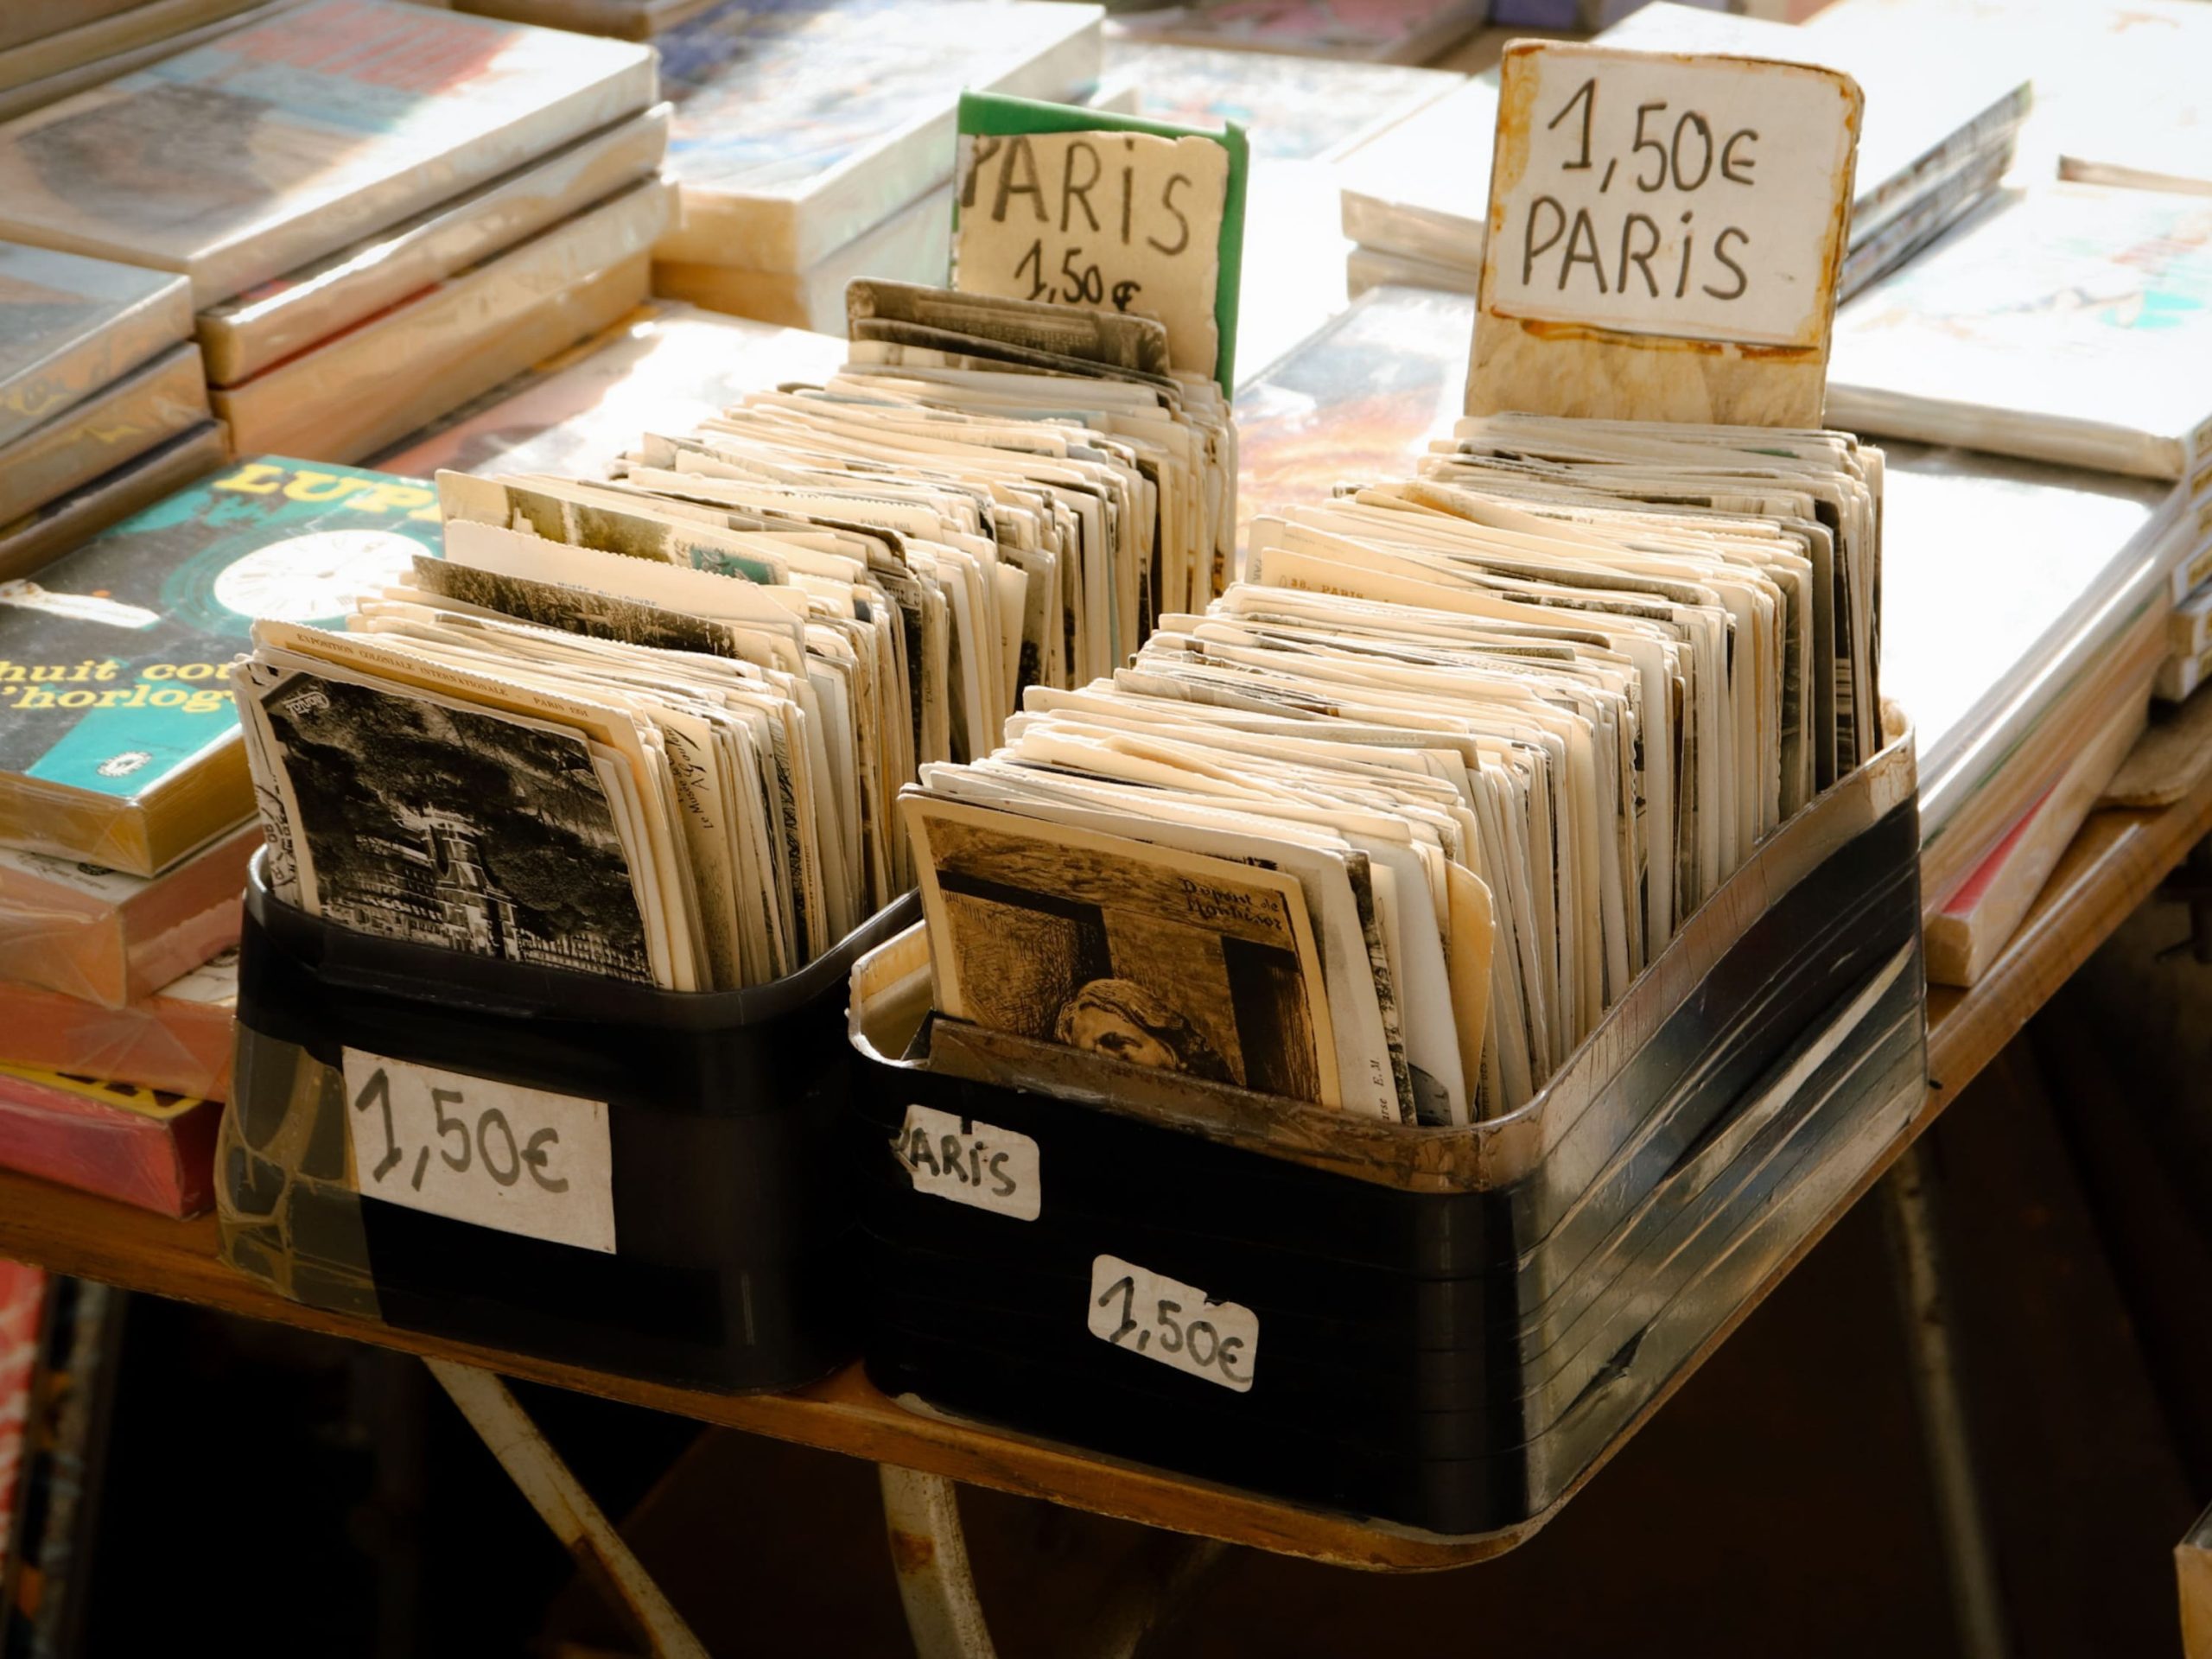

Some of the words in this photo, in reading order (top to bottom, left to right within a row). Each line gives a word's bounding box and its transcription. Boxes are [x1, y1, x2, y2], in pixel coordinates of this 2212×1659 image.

[1548, 77, 1759, 194] 1,50€
[296, 632, 354, 655] EXPOSITION
[359, 651, 416, 671] COLONIALE
[419, 666, 508, 697] INTERNATIONALE
[532, 696, 565, 711] PARIS
[354, 1068, 569, 1193] 1,50€
[1098, 1276, 1252, 1383] 1,50€
